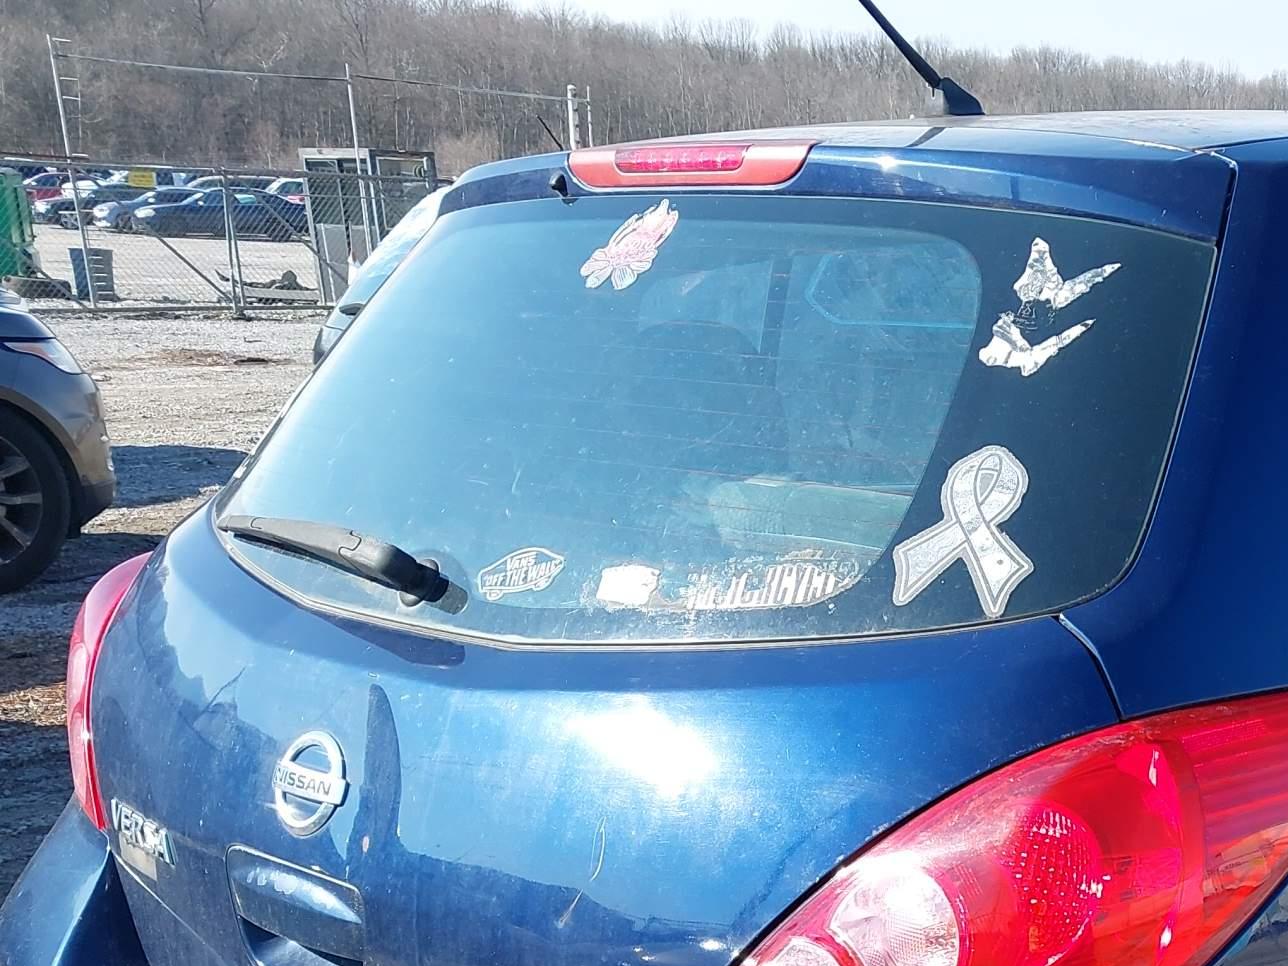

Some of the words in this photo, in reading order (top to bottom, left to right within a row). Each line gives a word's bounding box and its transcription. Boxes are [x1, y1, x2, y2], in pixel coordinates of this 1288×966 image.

[505, 552, 537, 571] VANS
[504, 567, 528, 587] THE
[273, 767, 332, 796] NISSAN
[110, 798, 177, 868] VERSA
